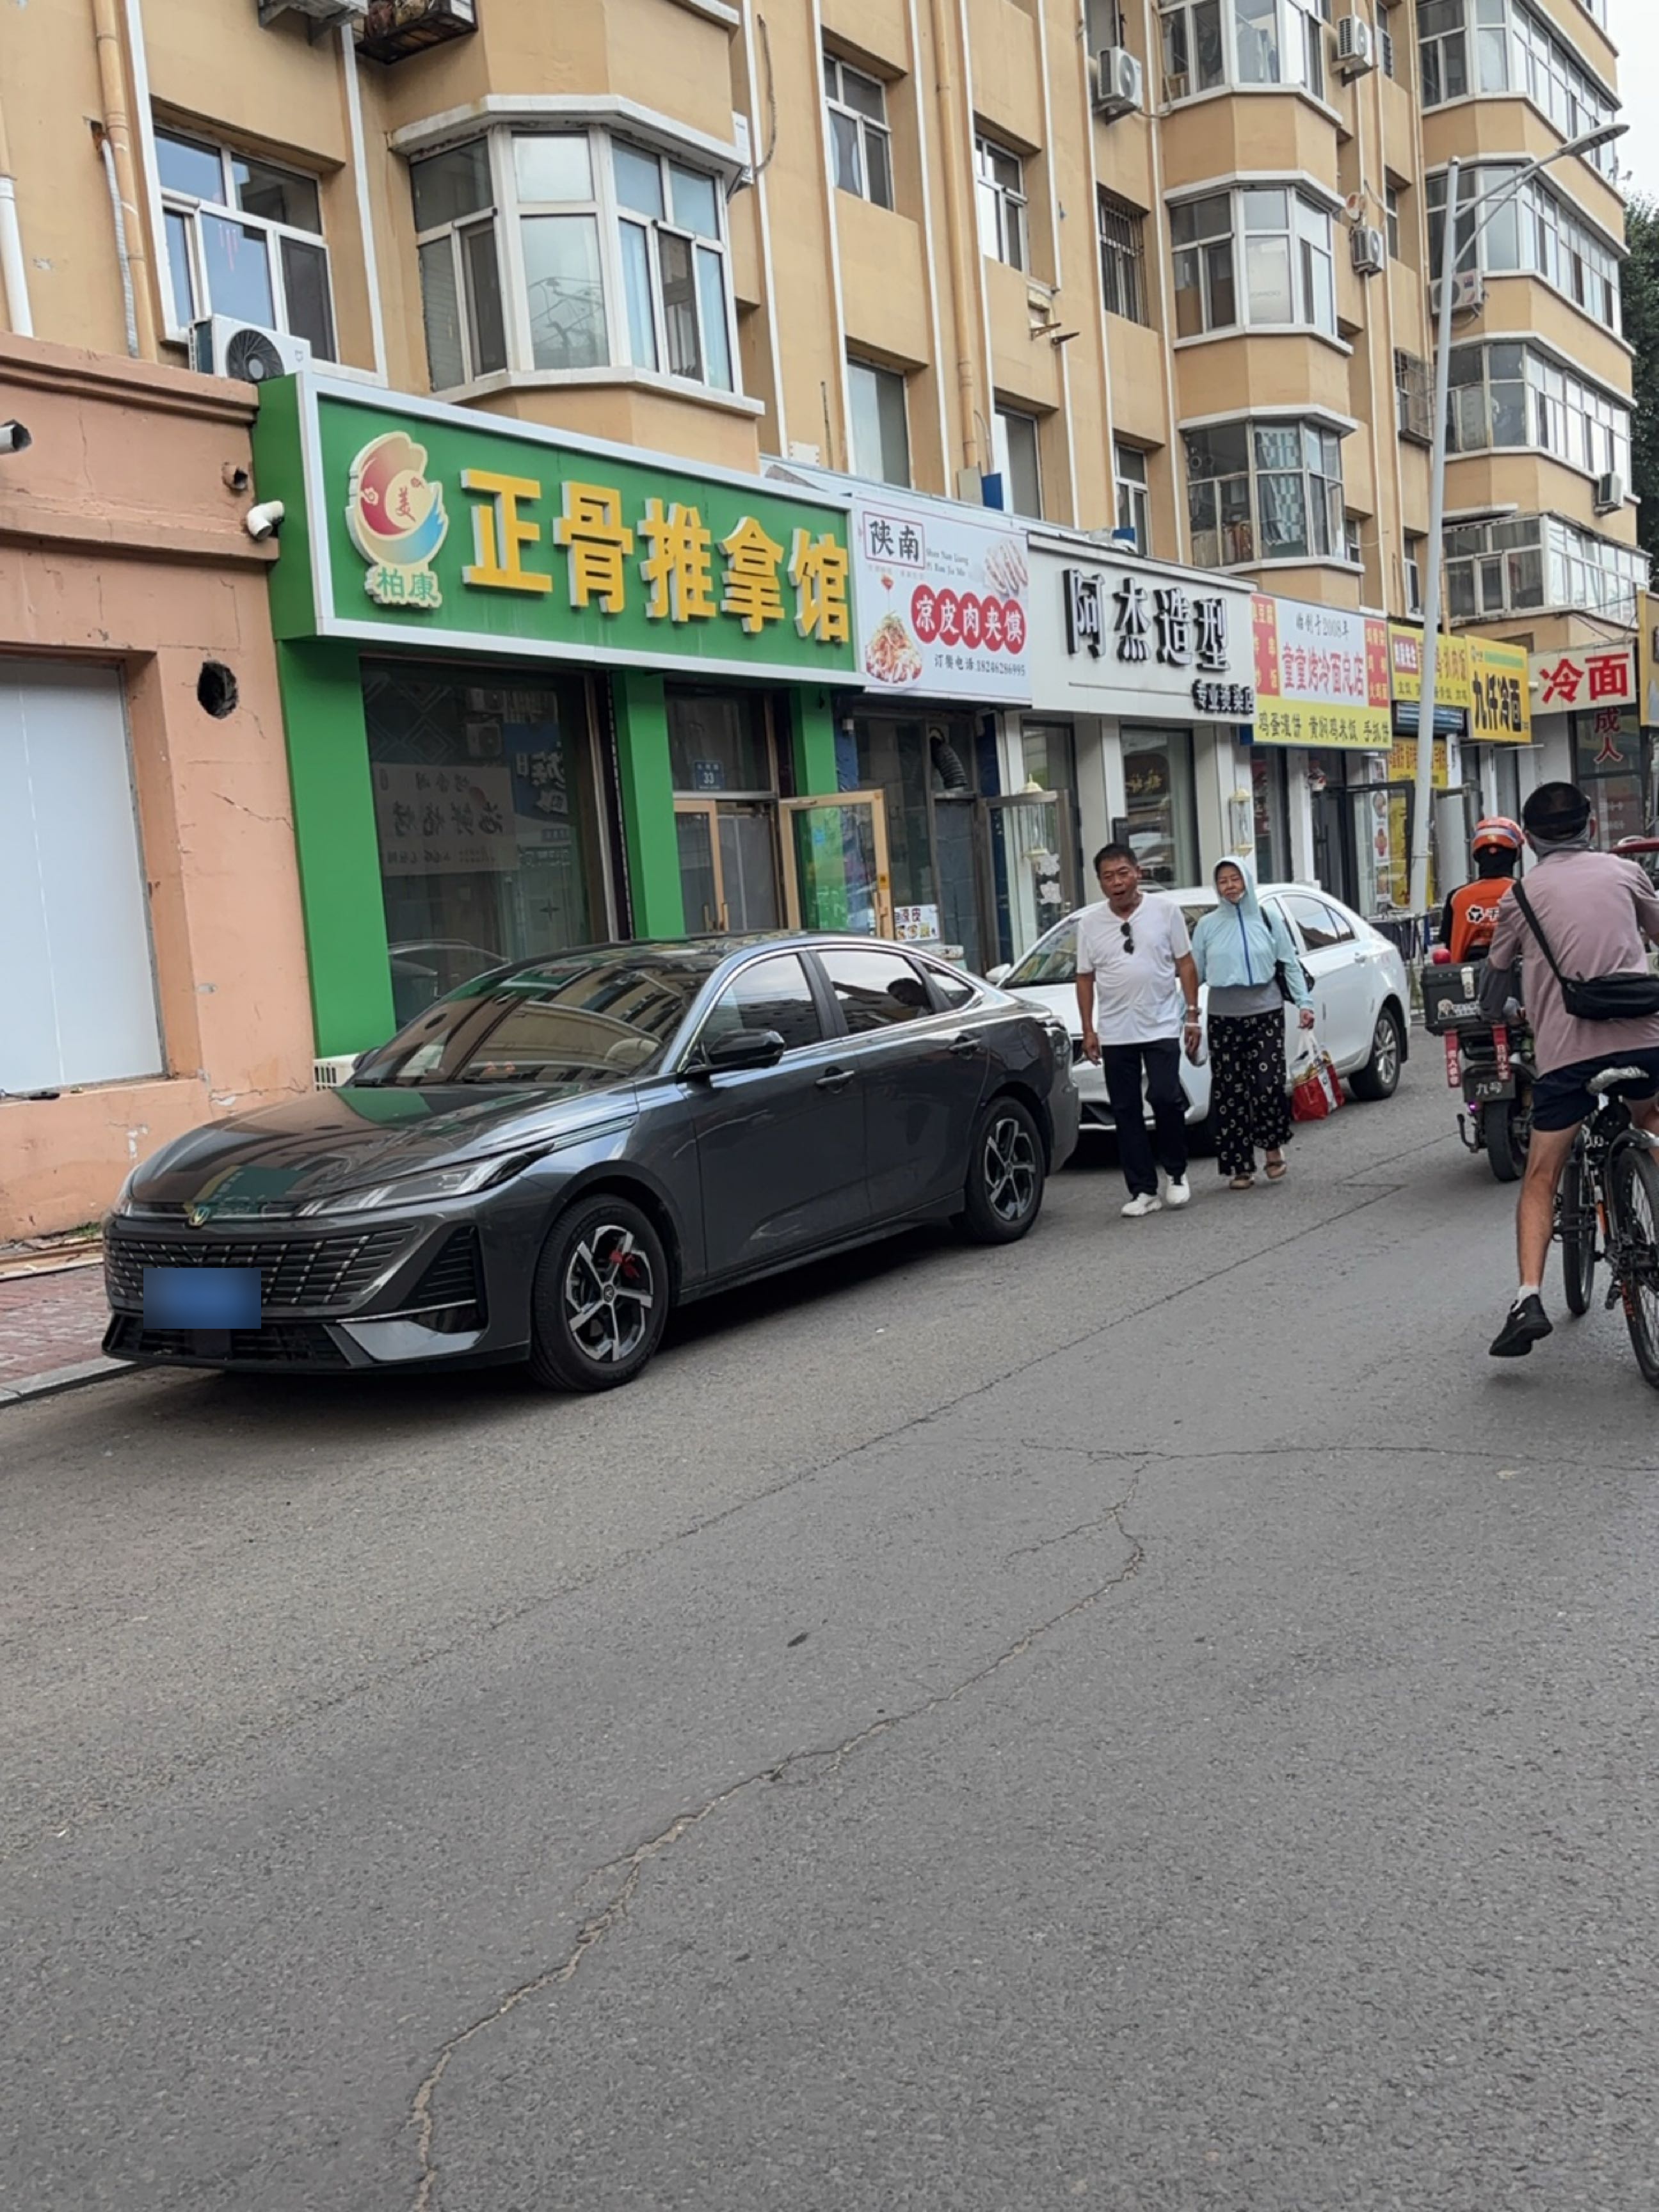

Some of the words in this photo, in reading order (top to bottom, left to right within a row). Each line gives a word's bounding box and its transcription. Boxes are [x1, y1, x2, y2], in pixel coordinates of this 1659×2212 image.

[460, 468, 849, 643] 正骨推拿馆
[869, 520, 920, 563] 陕南
[377, 566, 438, 602] 柏康
[1062, 568, 1230, 672] 阿杰造型
[1539, 653, 1629, 703] 冷面
[1594, 705, 1624, 764] 成人
